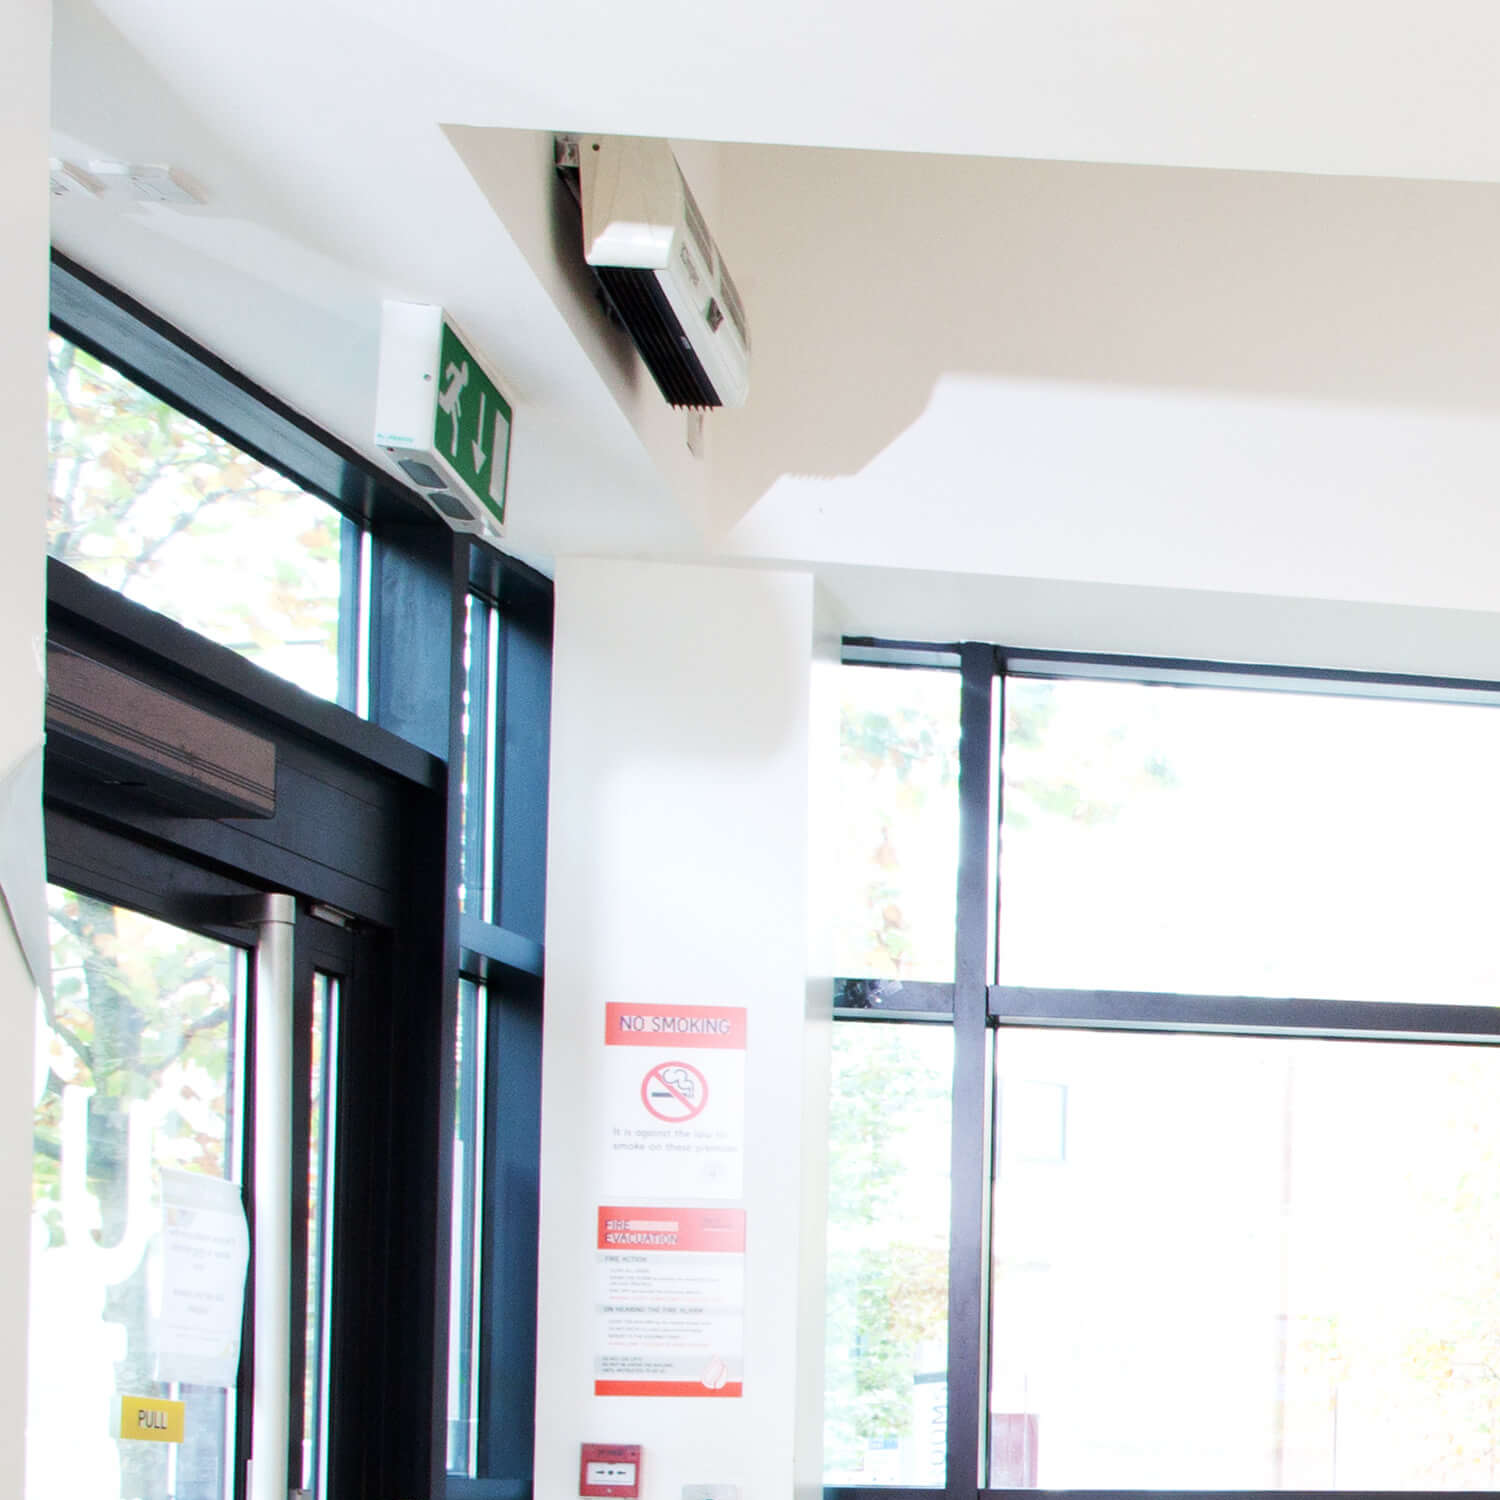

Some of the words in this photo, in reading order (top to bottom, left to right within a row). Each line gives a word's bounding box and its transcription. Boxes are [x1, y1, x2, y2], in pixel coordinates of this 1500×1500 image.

[620, 1016, 645, 1032] NO
[651, 1016, 731, 1034] SMOKING
[605, 1220, 631, 1231] FIRE
[605, 1233, 678, 1245] EVACUATION
[138, 1409, 168, 1430] PULL
